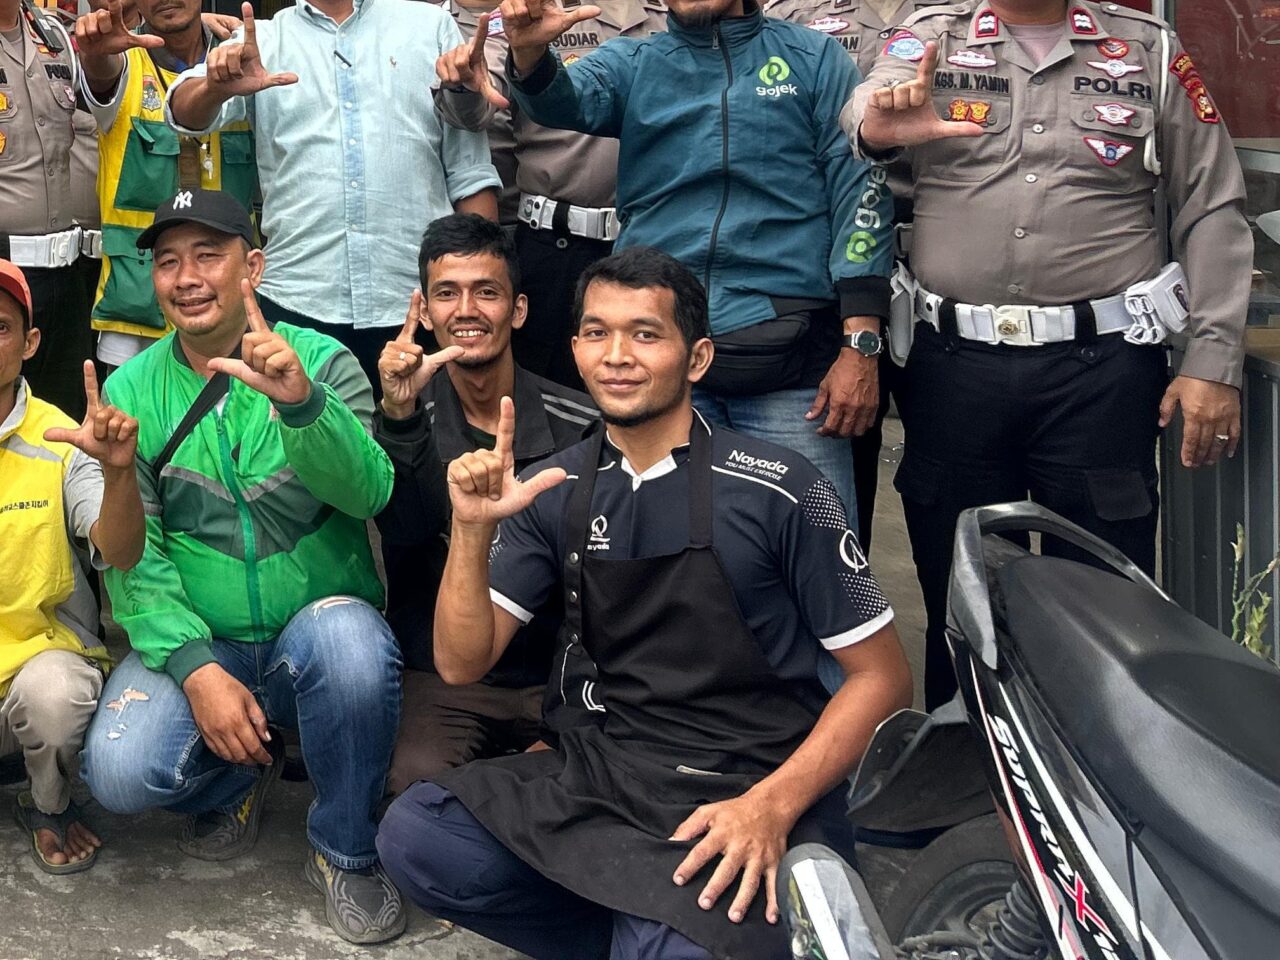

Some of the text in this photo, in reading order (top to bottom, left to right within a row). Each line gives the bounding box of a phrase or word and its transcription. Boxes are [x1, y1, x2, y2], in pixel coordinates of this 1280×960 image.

[756, 83, 798, 98] gojek
[973, 74, 1009, 93] YAMIN
[1074, 76, 1152, 100] POLRI
[728, 449, 788, 474] Nayada
